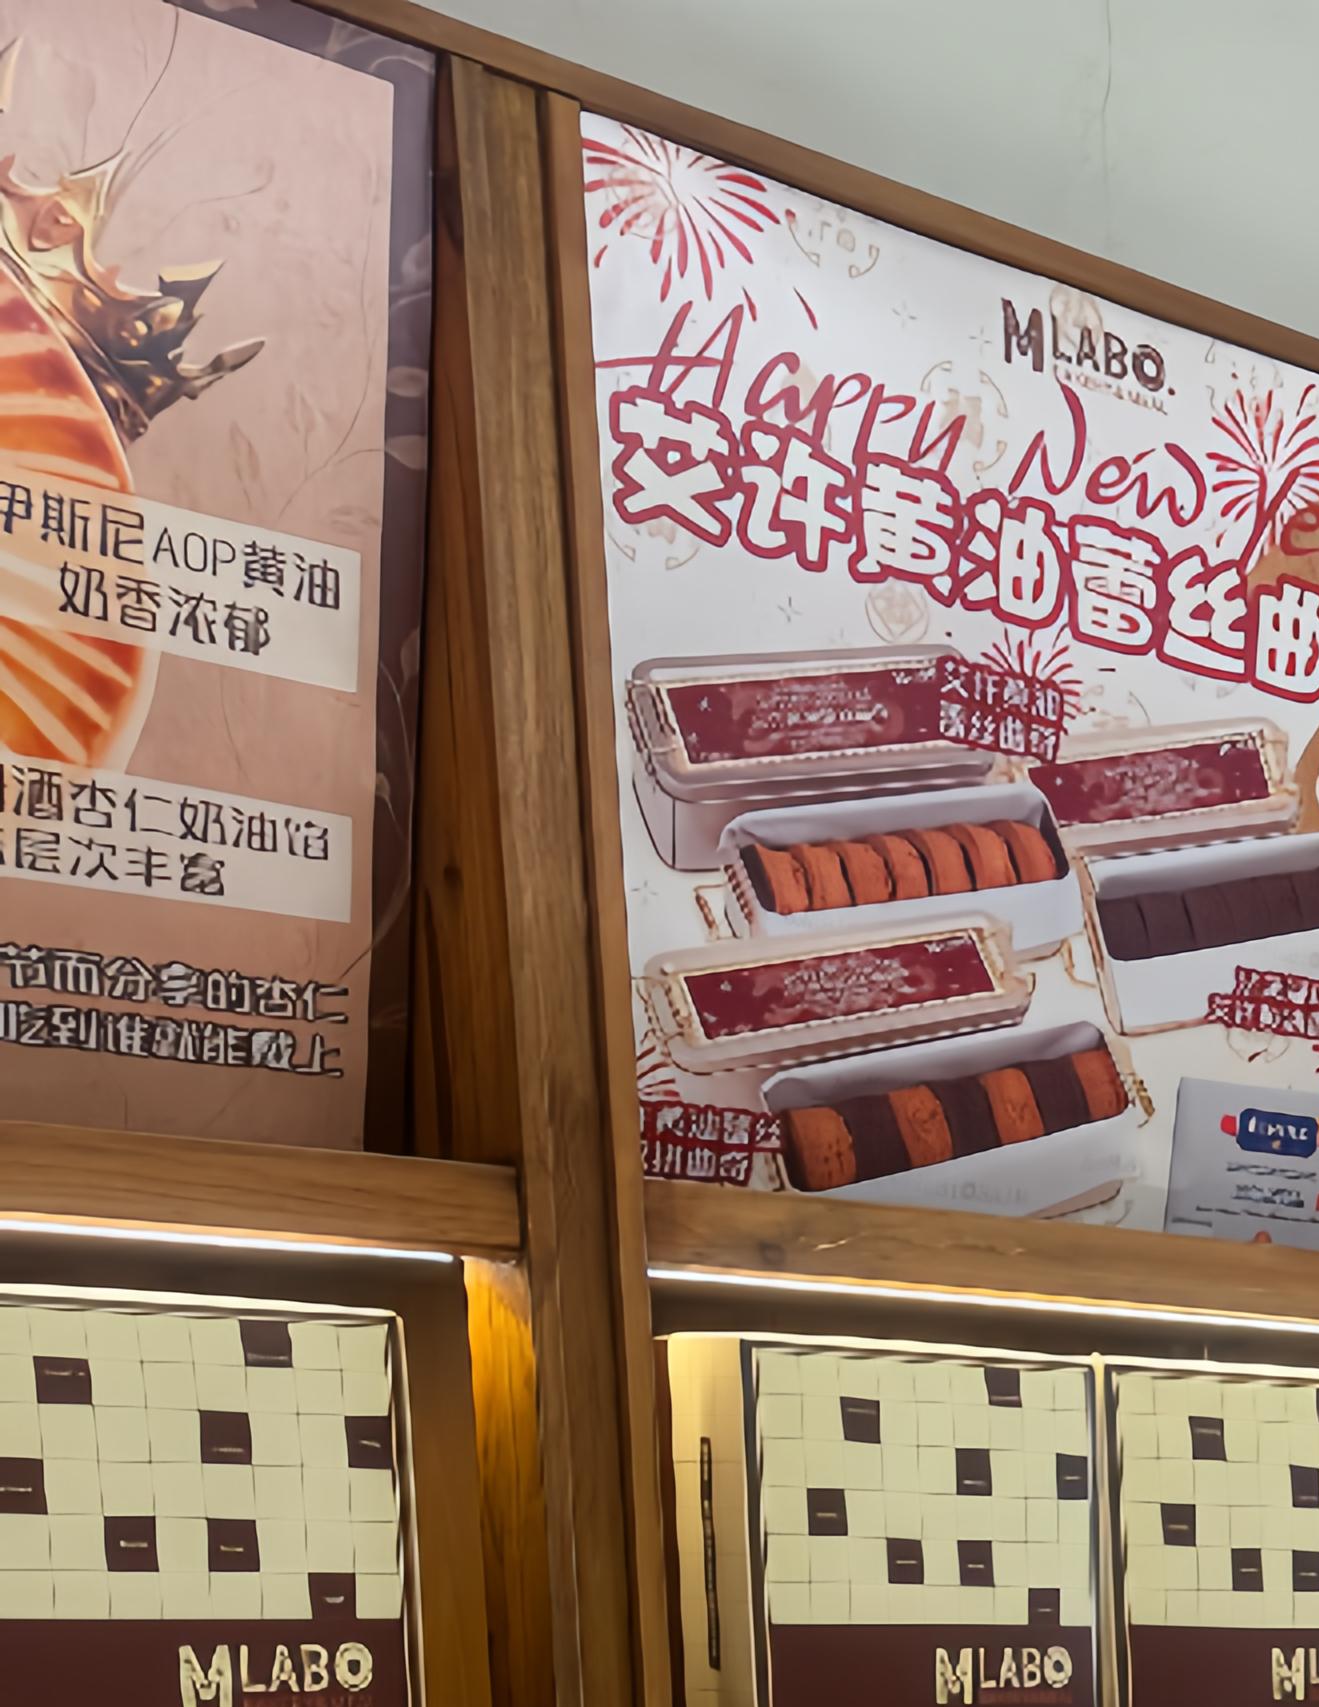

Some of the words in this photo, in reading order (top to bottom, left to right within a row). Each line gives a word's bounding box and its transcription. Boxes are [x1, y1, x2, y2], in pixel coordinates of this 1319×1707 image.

[1008, 384, 1208, 530] New
[58, 561, 271, 656] 奶香浓郁
[0, 763, 330, 861] 酒杏仁奶油馅
[0, 827, 225, 896] 层次丰富
[935, 1645, 1074, 1706] MLABO
